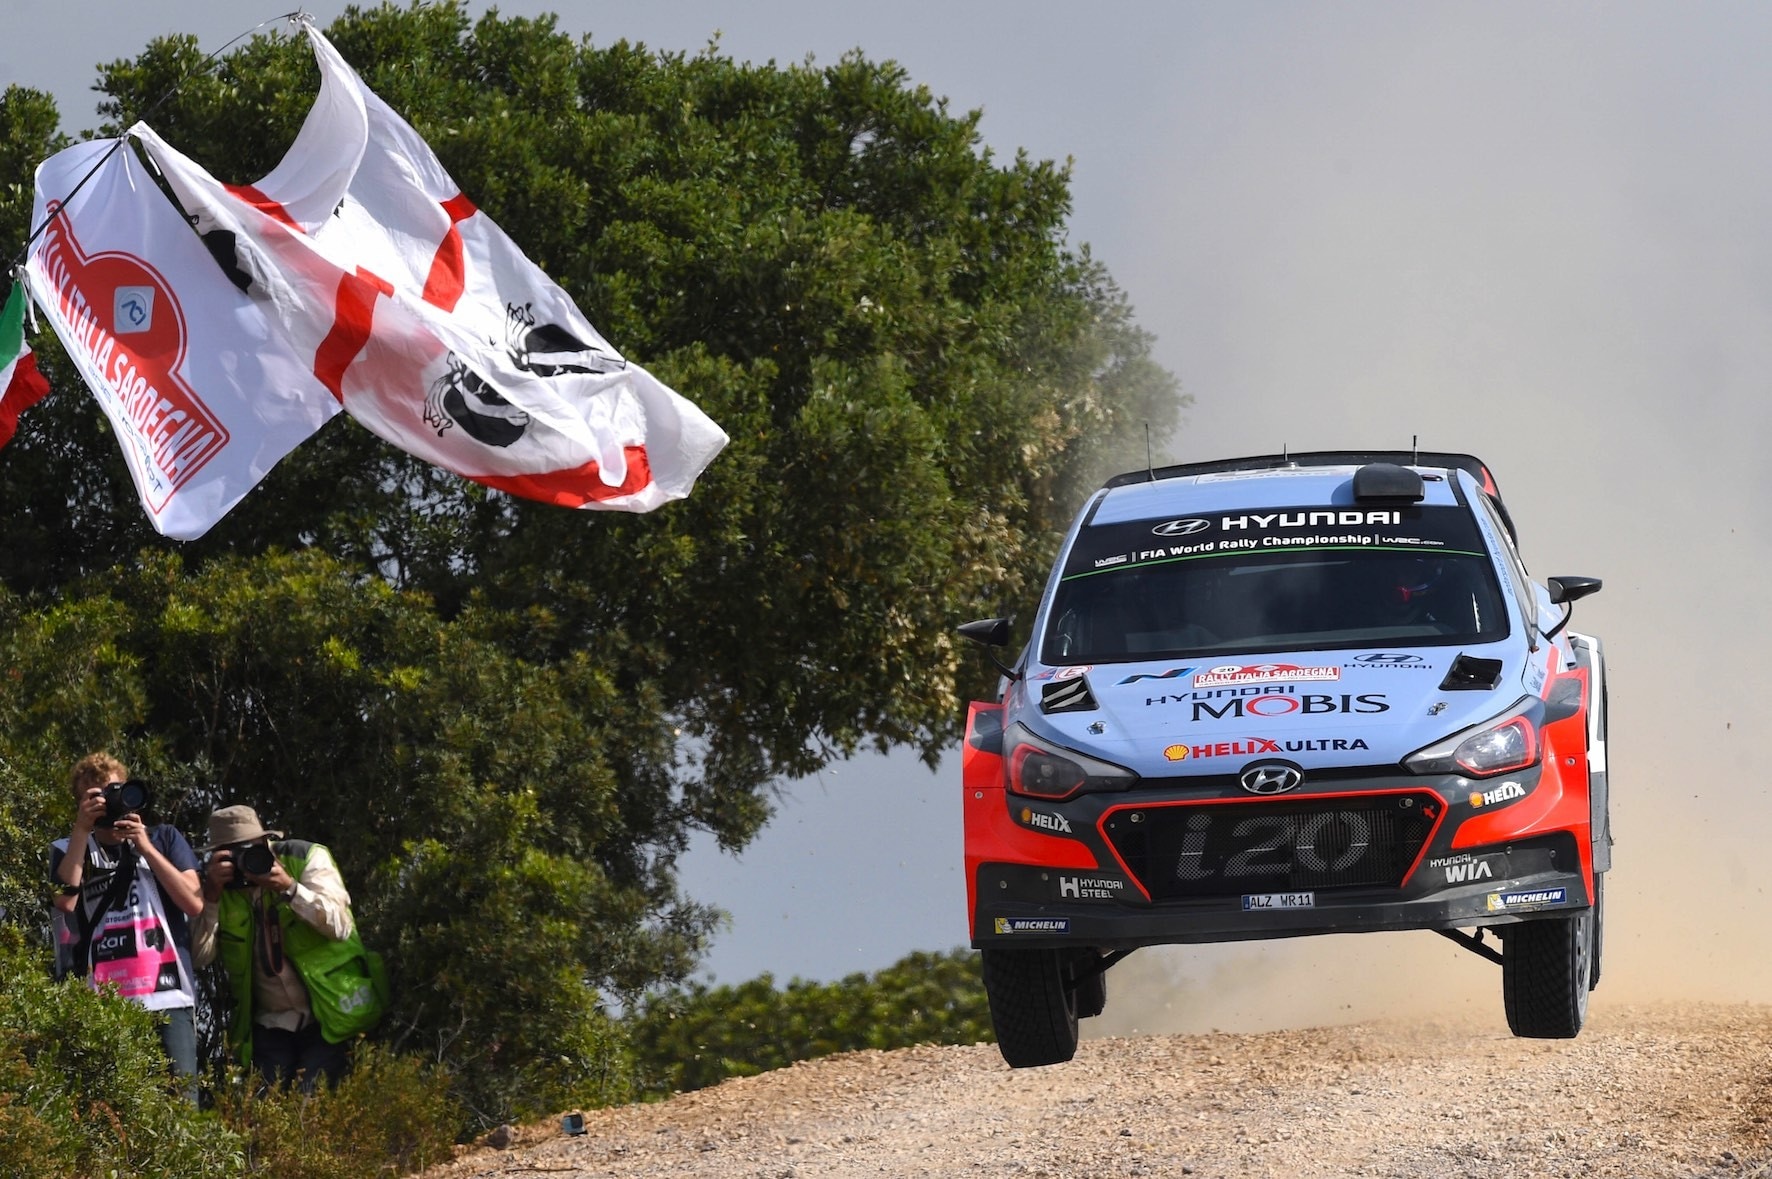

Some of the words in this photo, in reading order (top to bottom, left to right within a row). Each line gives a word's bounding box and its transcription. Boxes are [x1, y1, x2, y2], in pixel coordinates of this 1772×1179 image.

[66, 284, 114, 378] ITALIA
[110, 353, 215, 485] SARDEGNA
[1221, 511, 1400, 530] HYUNDAI
[1140, 549, 1166, 560] FIA
[1170, 542, 1215, 555] World
[1219, 536, 1258, 550] Rally
[1262, 534, 1372, 546] Championship
[1199, 673, 1234, 684] RALLY
[1235, 671, 1272, 680] ITALIA
[1273, 667, 1333, 677] SARDEGNA
[1146, 686, 1294, 706] HYUNDAI
[1191, 694, 1390, 721] MOBIS
[1192, 737, 1285, 759] HELIX
[1285, 739, 1369, 751] ULTRA
[1483, 781, 1526, 805] HELIX
[1031, 811, 1073, 834] HELIX
[1176, 811, 1370, 880] i20
[1430, 853, 1471, 868] HYUNDAI
[1445, 859, 1493, 883] WIA
[1080, 878, 1124, 890] HYUNDAI
[1081, 889, 1113, 898] STEEL
[1250, 895, 1273, 908] ALZ
[1506, 891, 1562, 904] MICHELIN
[1014, 920, 1067, 930] MICHELIN
